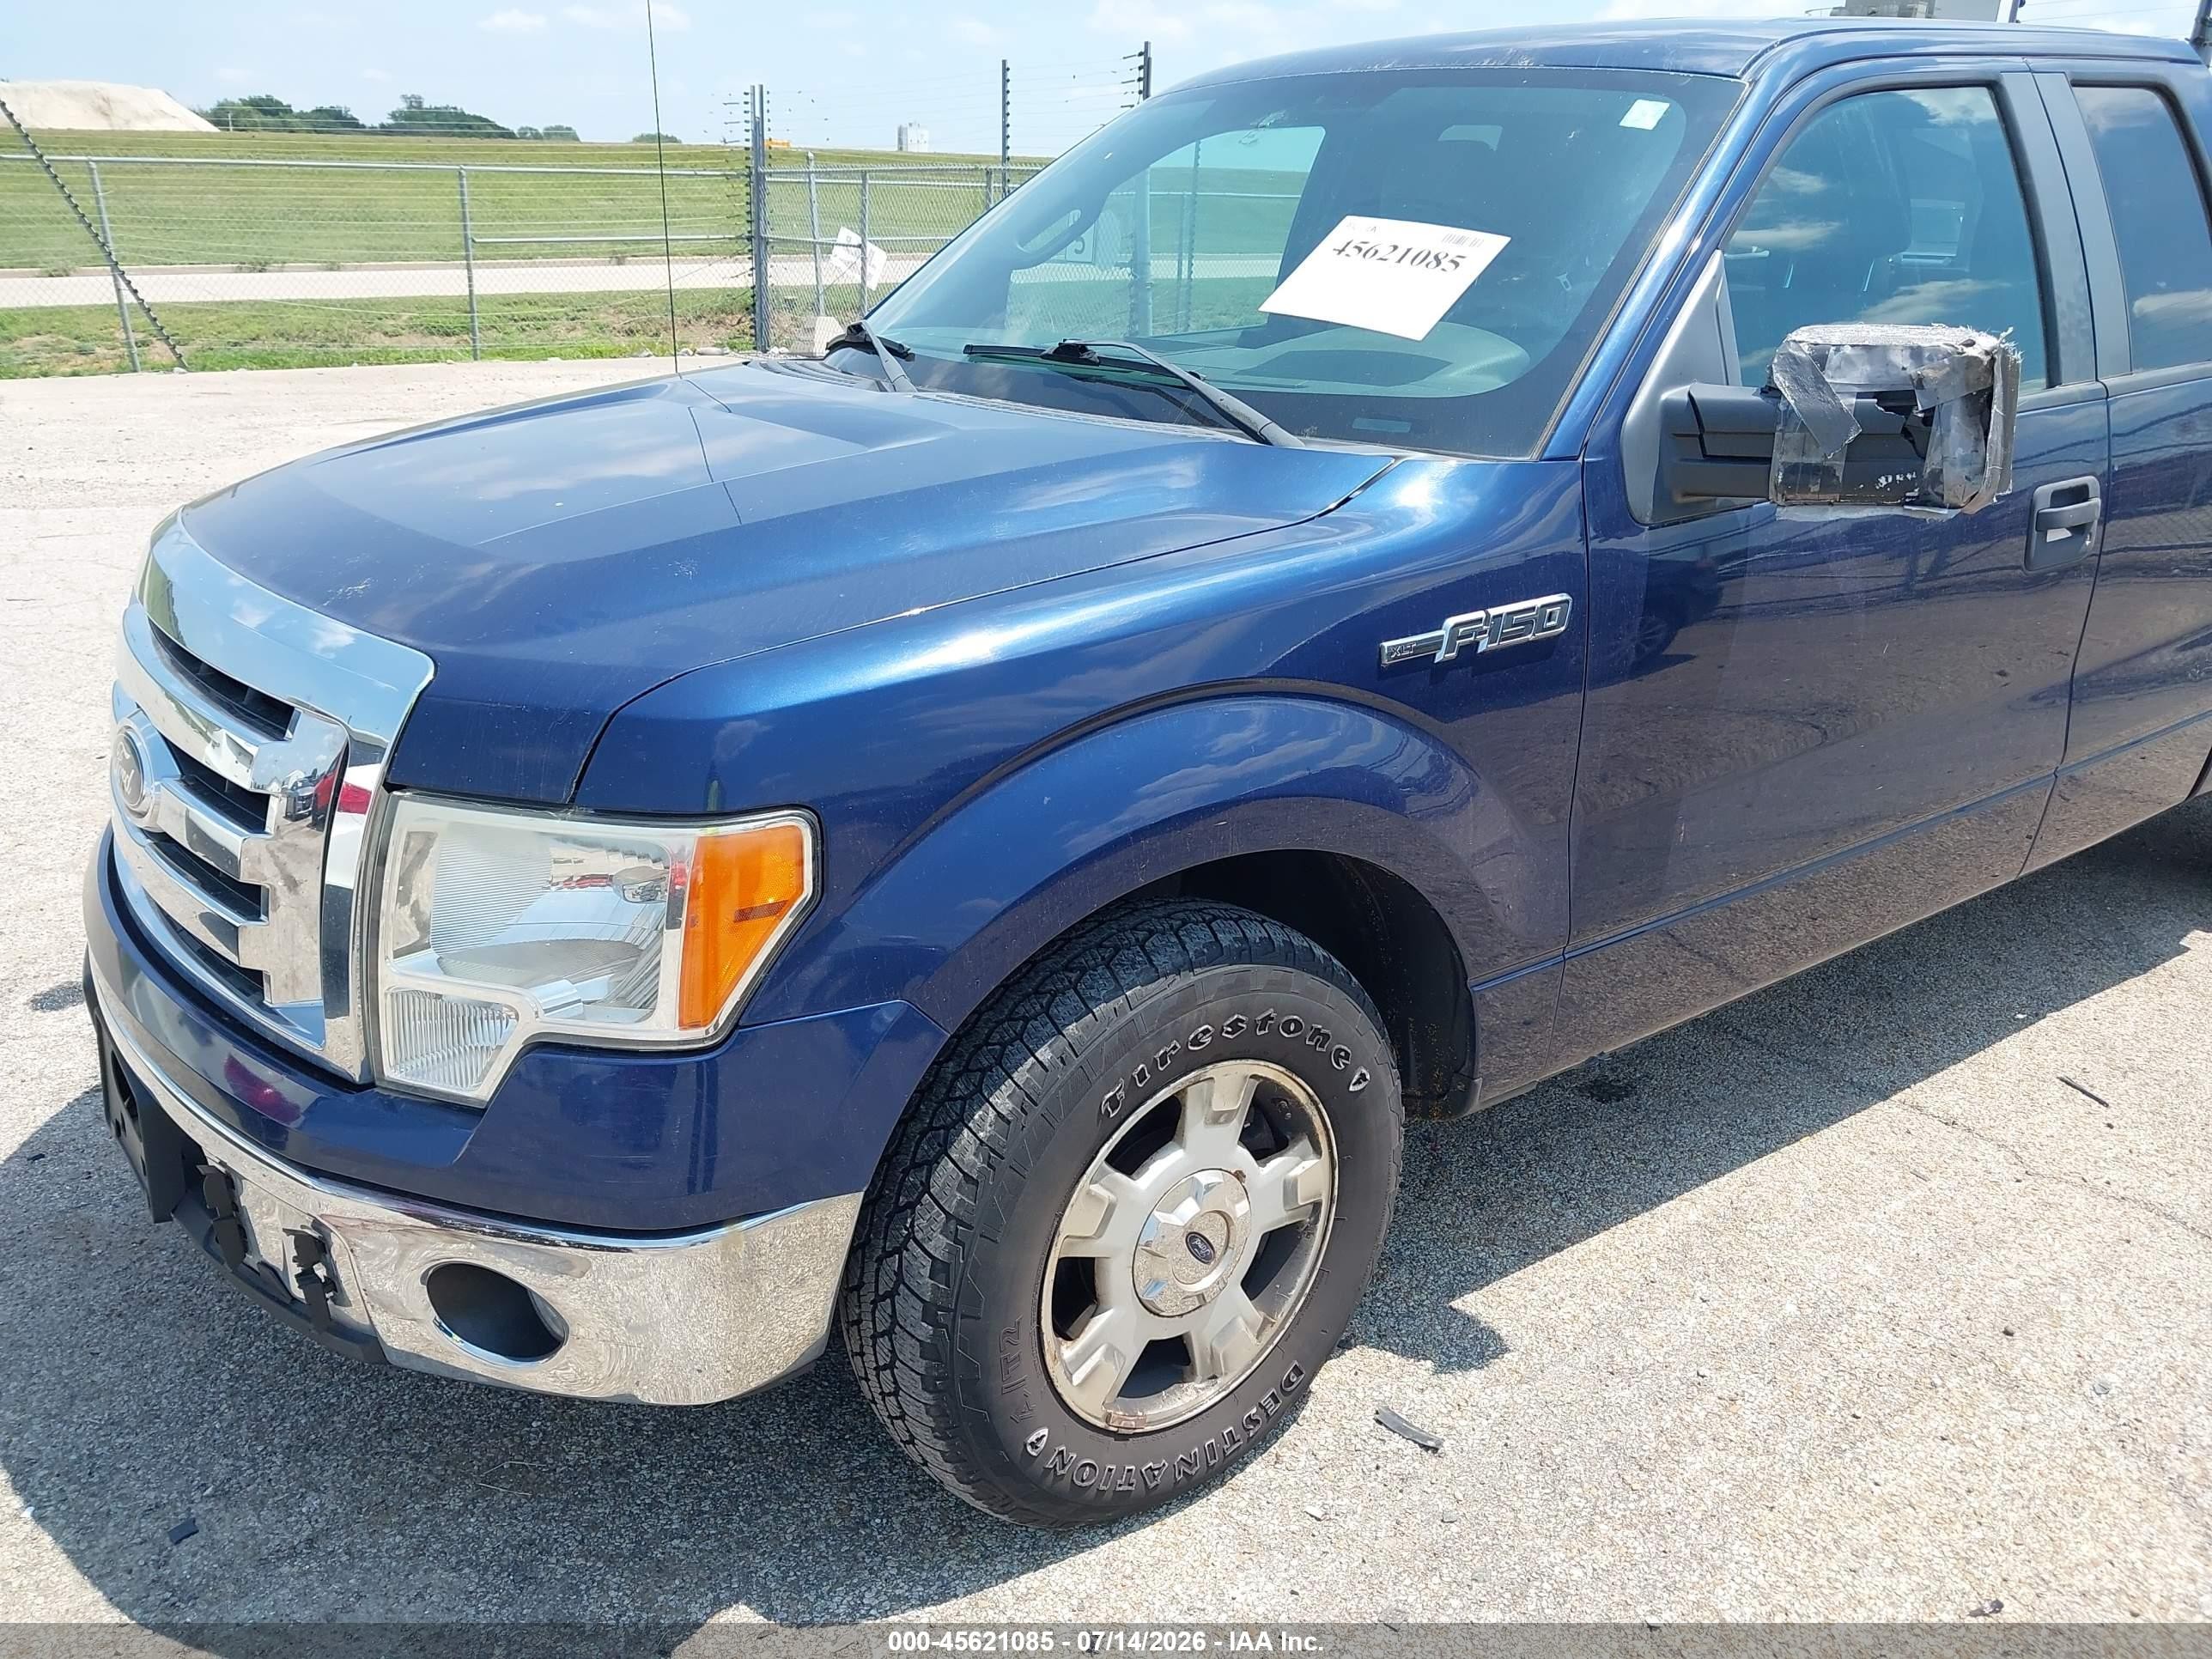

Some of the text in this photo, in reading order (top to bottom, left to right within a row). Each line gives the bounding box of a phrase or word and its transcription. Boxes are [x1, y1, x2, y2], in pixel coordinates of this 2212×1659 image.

[1333, 239, 1467, 272] 45621085
[1390, 641, 1417, 658] XLT
[1101, 1007, 1352, 1118] Firestone
[1044, 1359, 1305, 1492] DESTINATION
